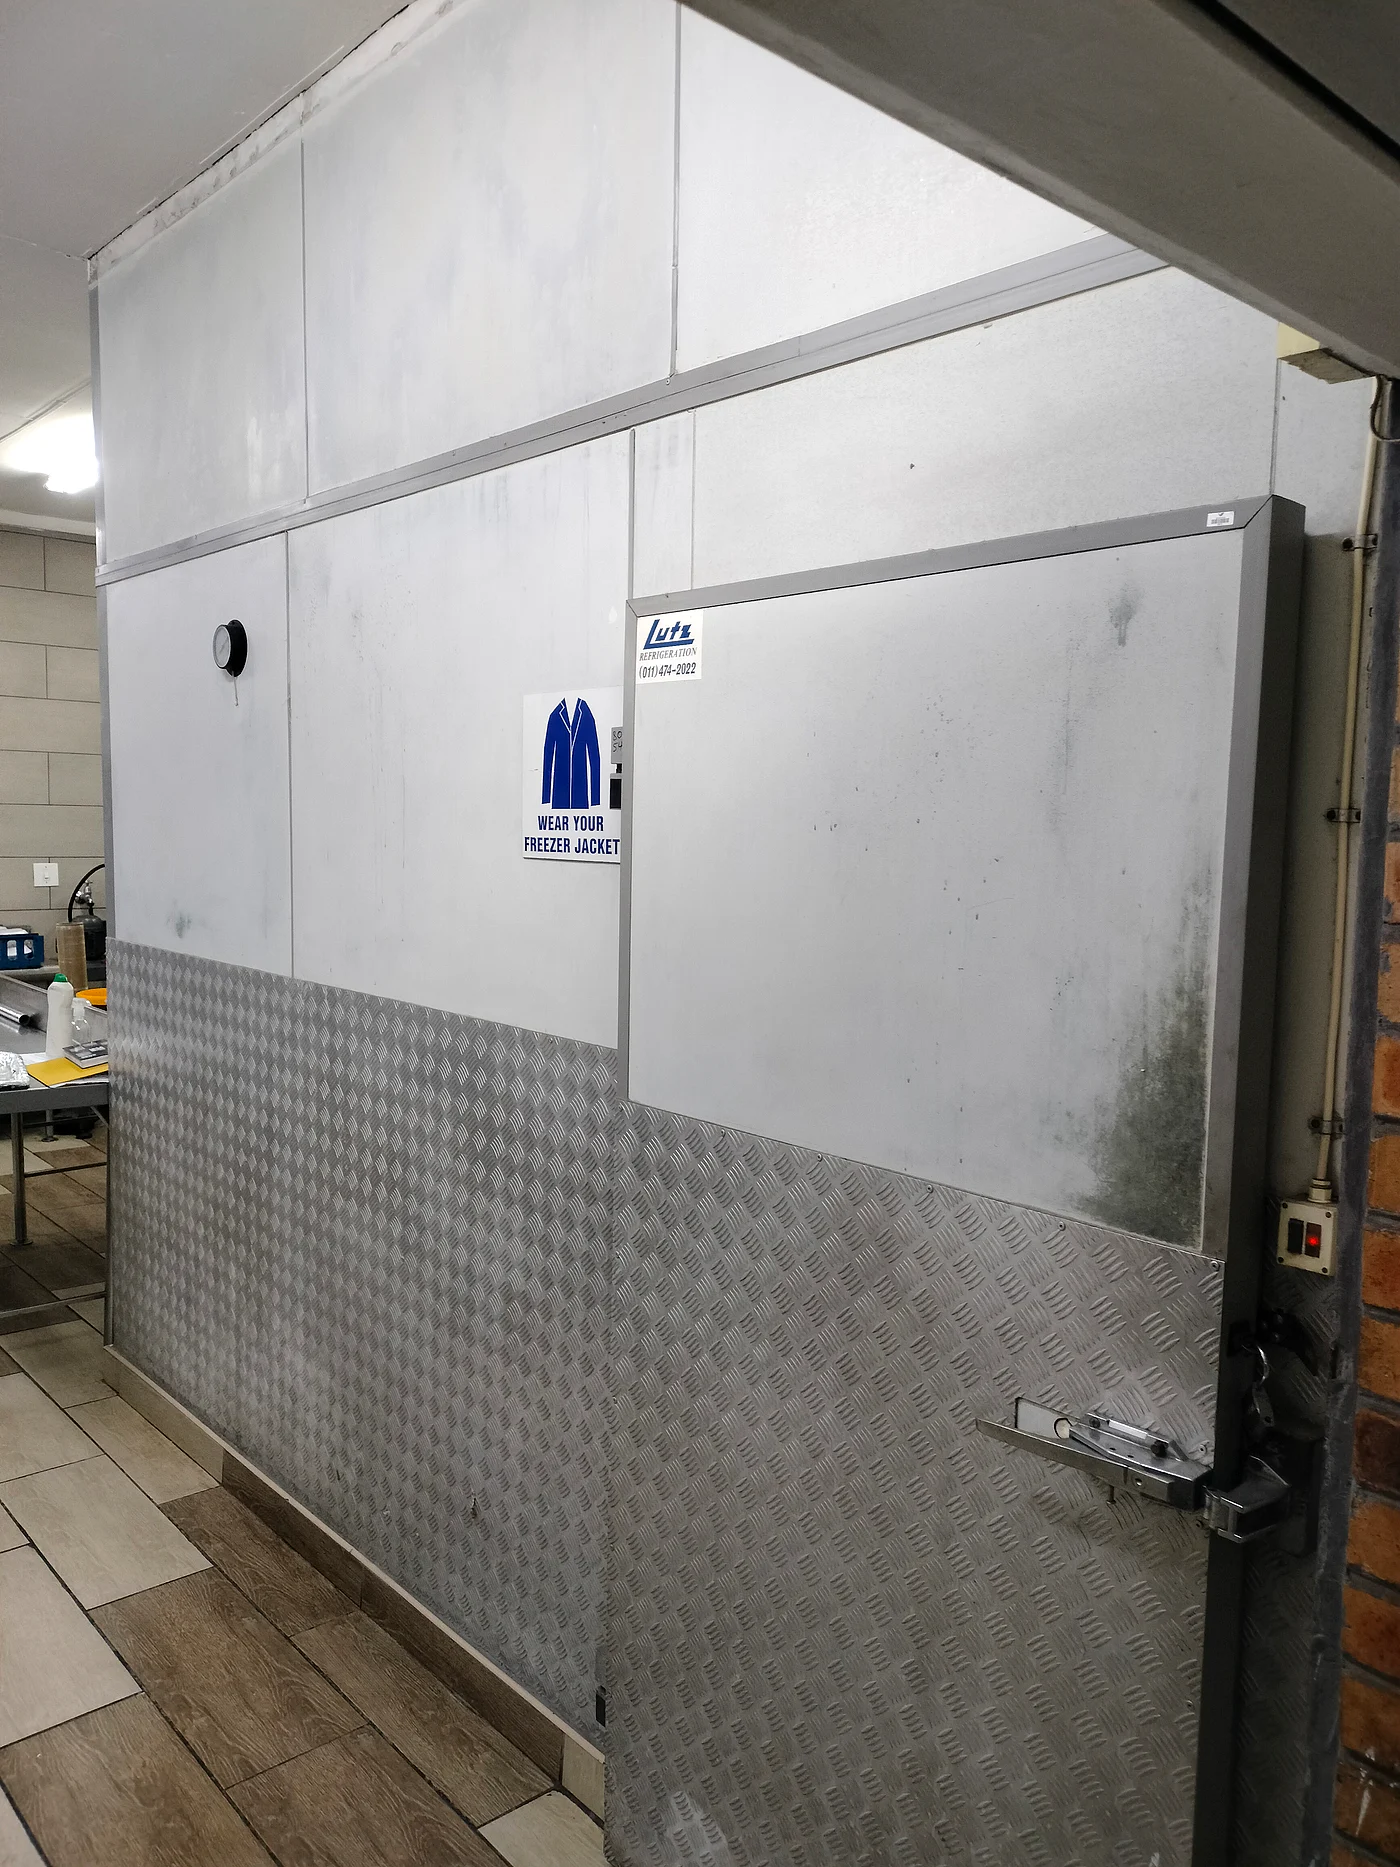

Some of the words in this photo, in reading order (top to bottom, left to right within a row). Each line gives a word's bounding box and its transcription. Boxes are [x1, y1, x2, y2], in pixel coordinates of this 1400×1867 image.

[643, 619, 695, 650] Lutz
[639, 647, 698, 661] REFRIGERATION
[538, 815, 569, 831] WEAR
[573, 815, 604, 832] YOUR
[524, 836, 571, 853] FREEZER
[574, 838, 621, 855] JACKET
